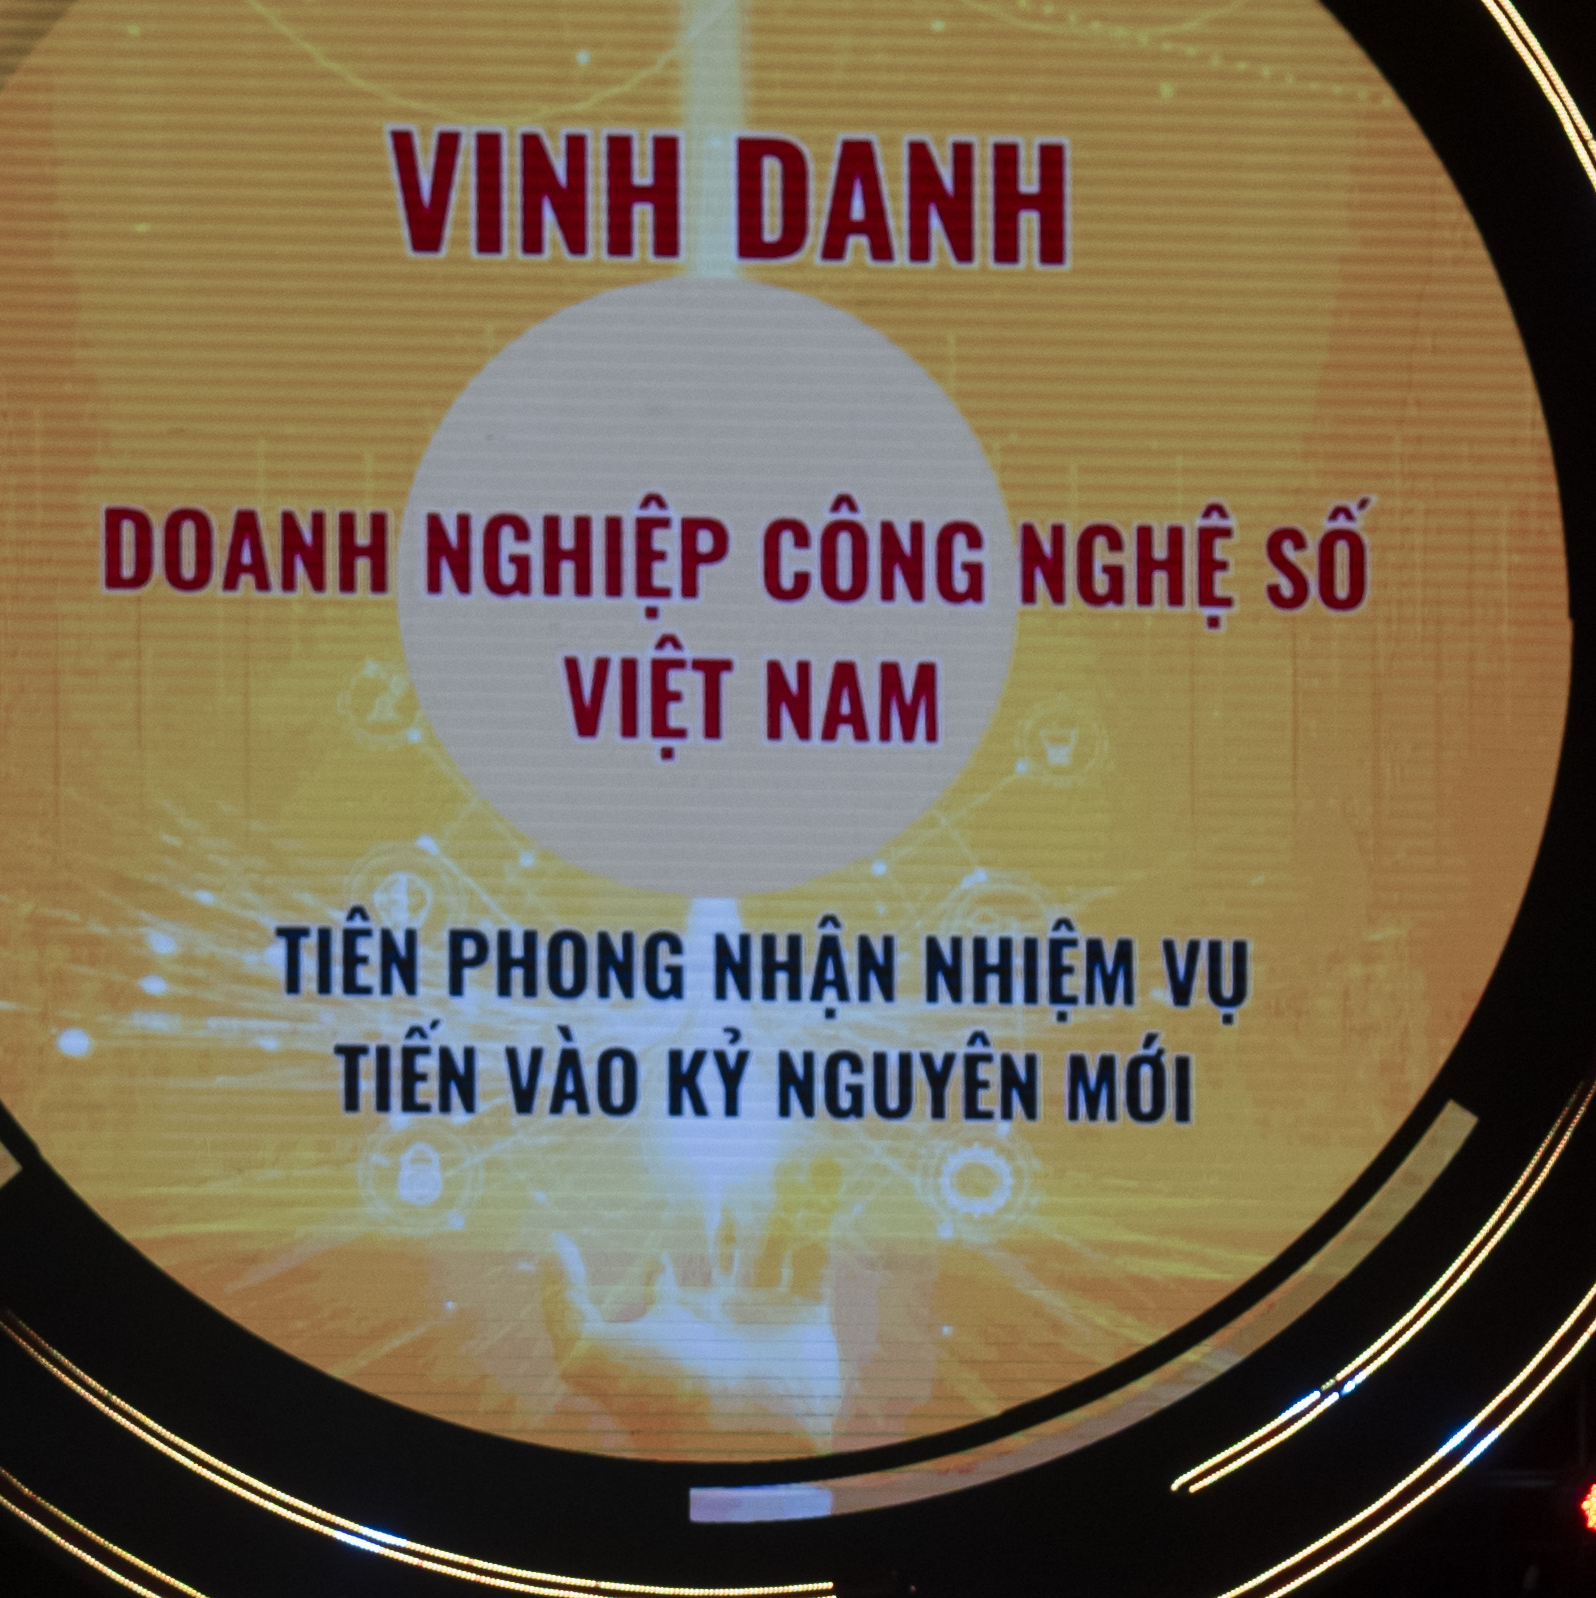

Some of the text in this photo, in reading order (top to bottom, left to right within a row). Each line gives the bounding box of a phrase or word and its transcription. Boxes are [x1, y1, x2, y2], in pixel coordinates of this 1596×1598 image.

[390, 130, 1065, 265] VINH DANH
[104, 493, 1372, 629] DOANH NGHIỆP CÔNG NGHỆ SỐ
[564, 634, 938, 760] VIỆT NAM
[276, 906, 1247, 1025] TIÊN PHONG NHẬN NHIỆM VỤ
[334, 1018, 1190, 1123] TIẾN VÀO KỶ NGUYÊN MỚI
